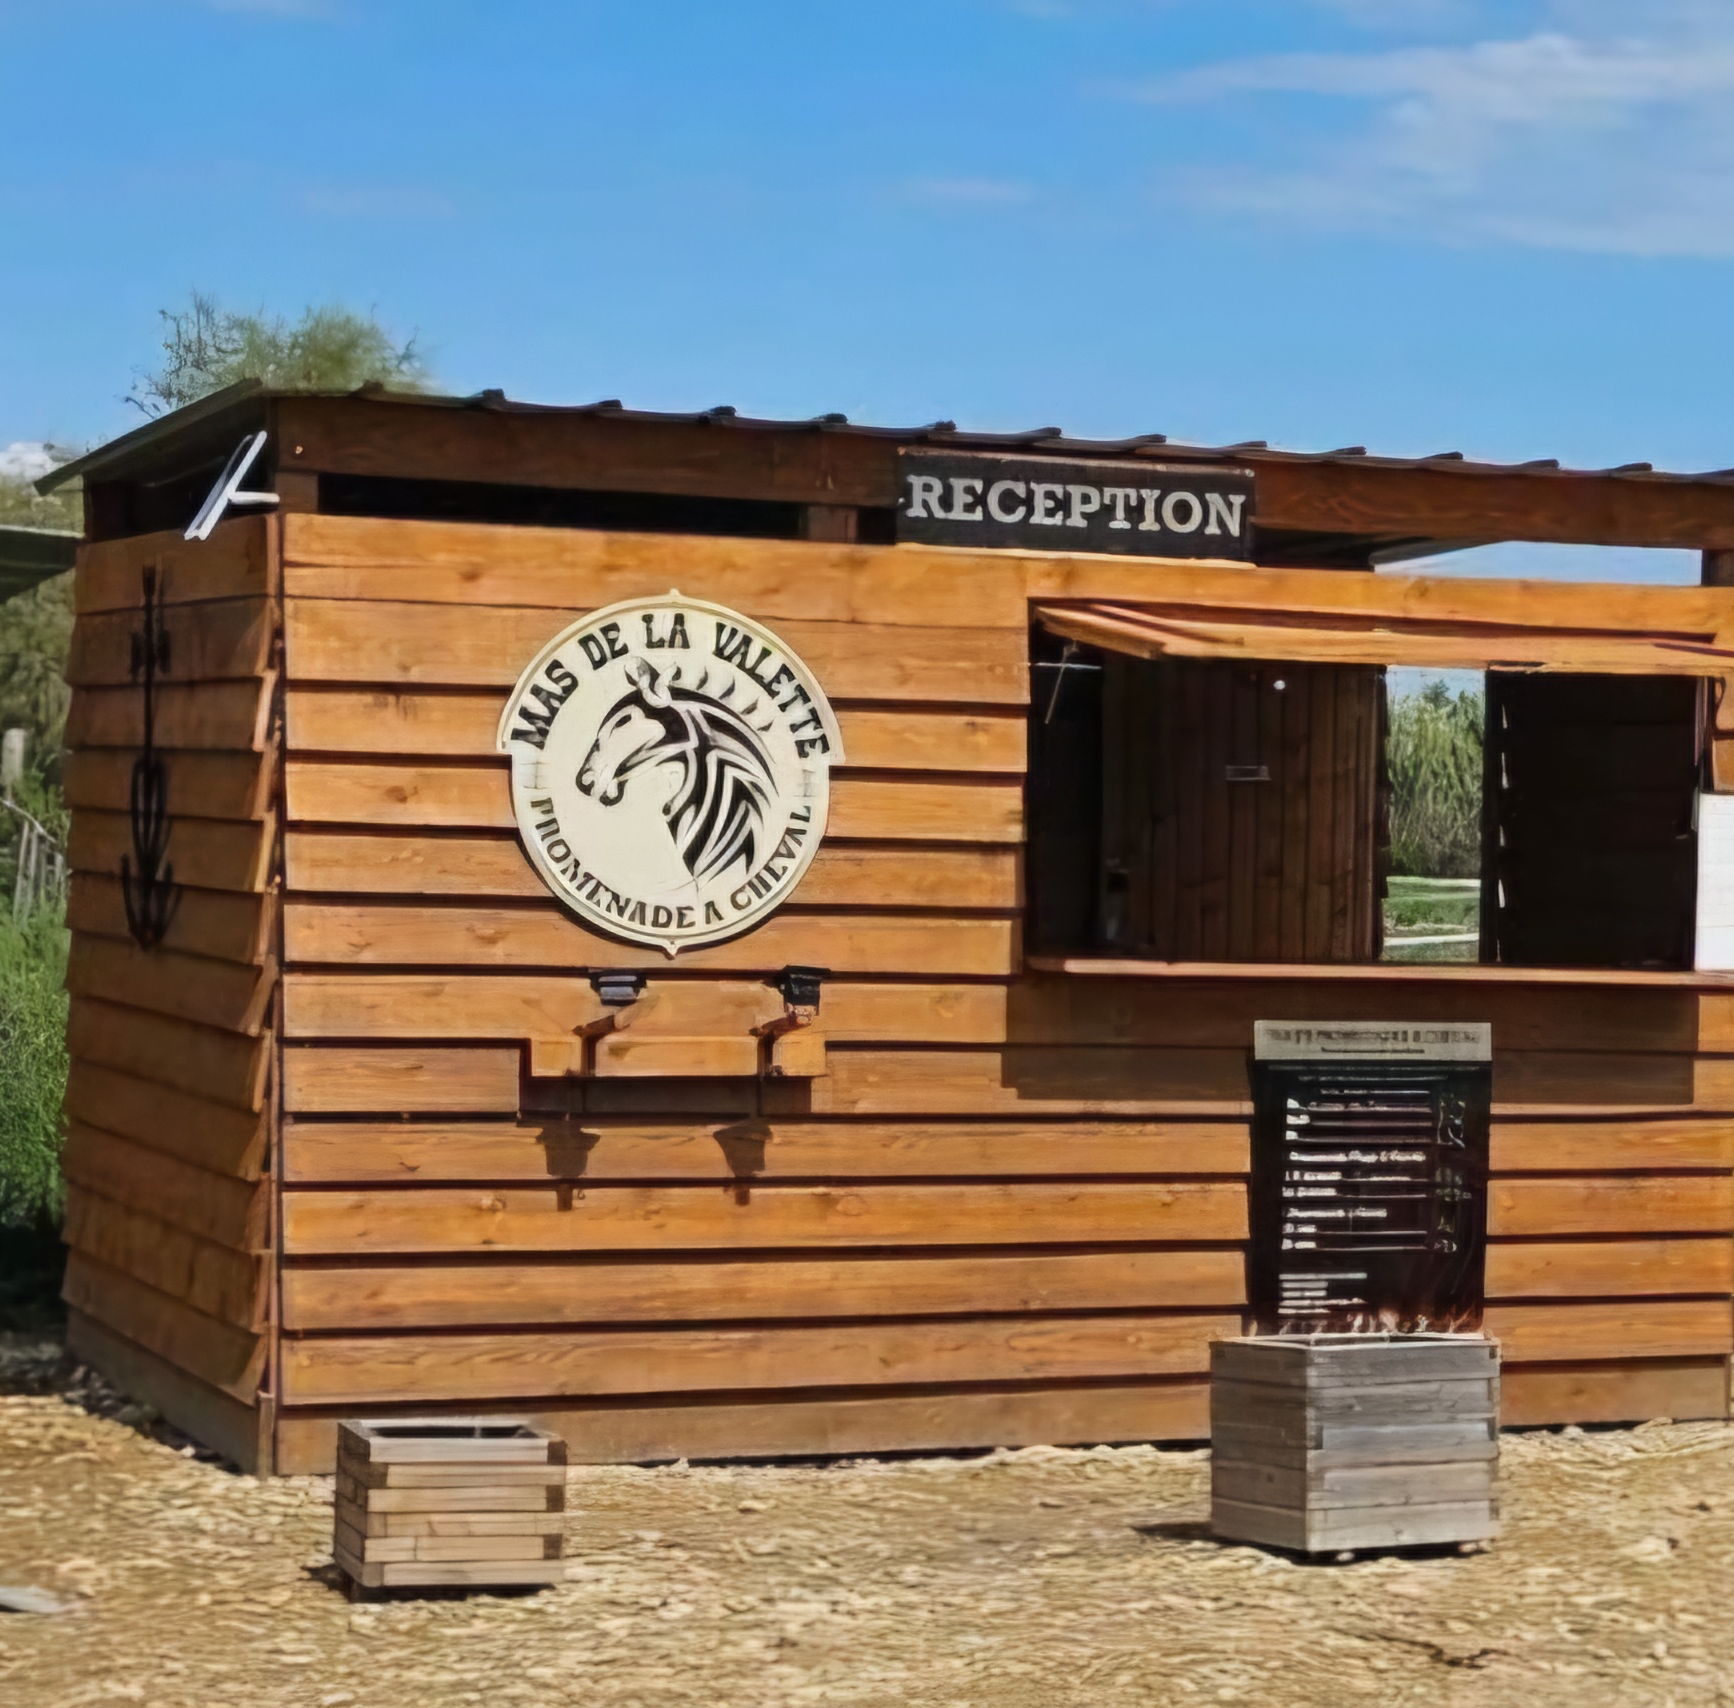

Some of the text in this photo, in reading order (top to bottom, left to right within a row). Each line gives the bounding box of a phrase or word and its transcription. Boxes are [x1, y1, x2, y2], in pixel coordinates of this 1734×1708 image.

[905, 473, 1246, 537] RECEPTION
[510, 612, 830, 759] MAS DE LA VALETTE
[530, 797, 696, 929] PROMENADE
